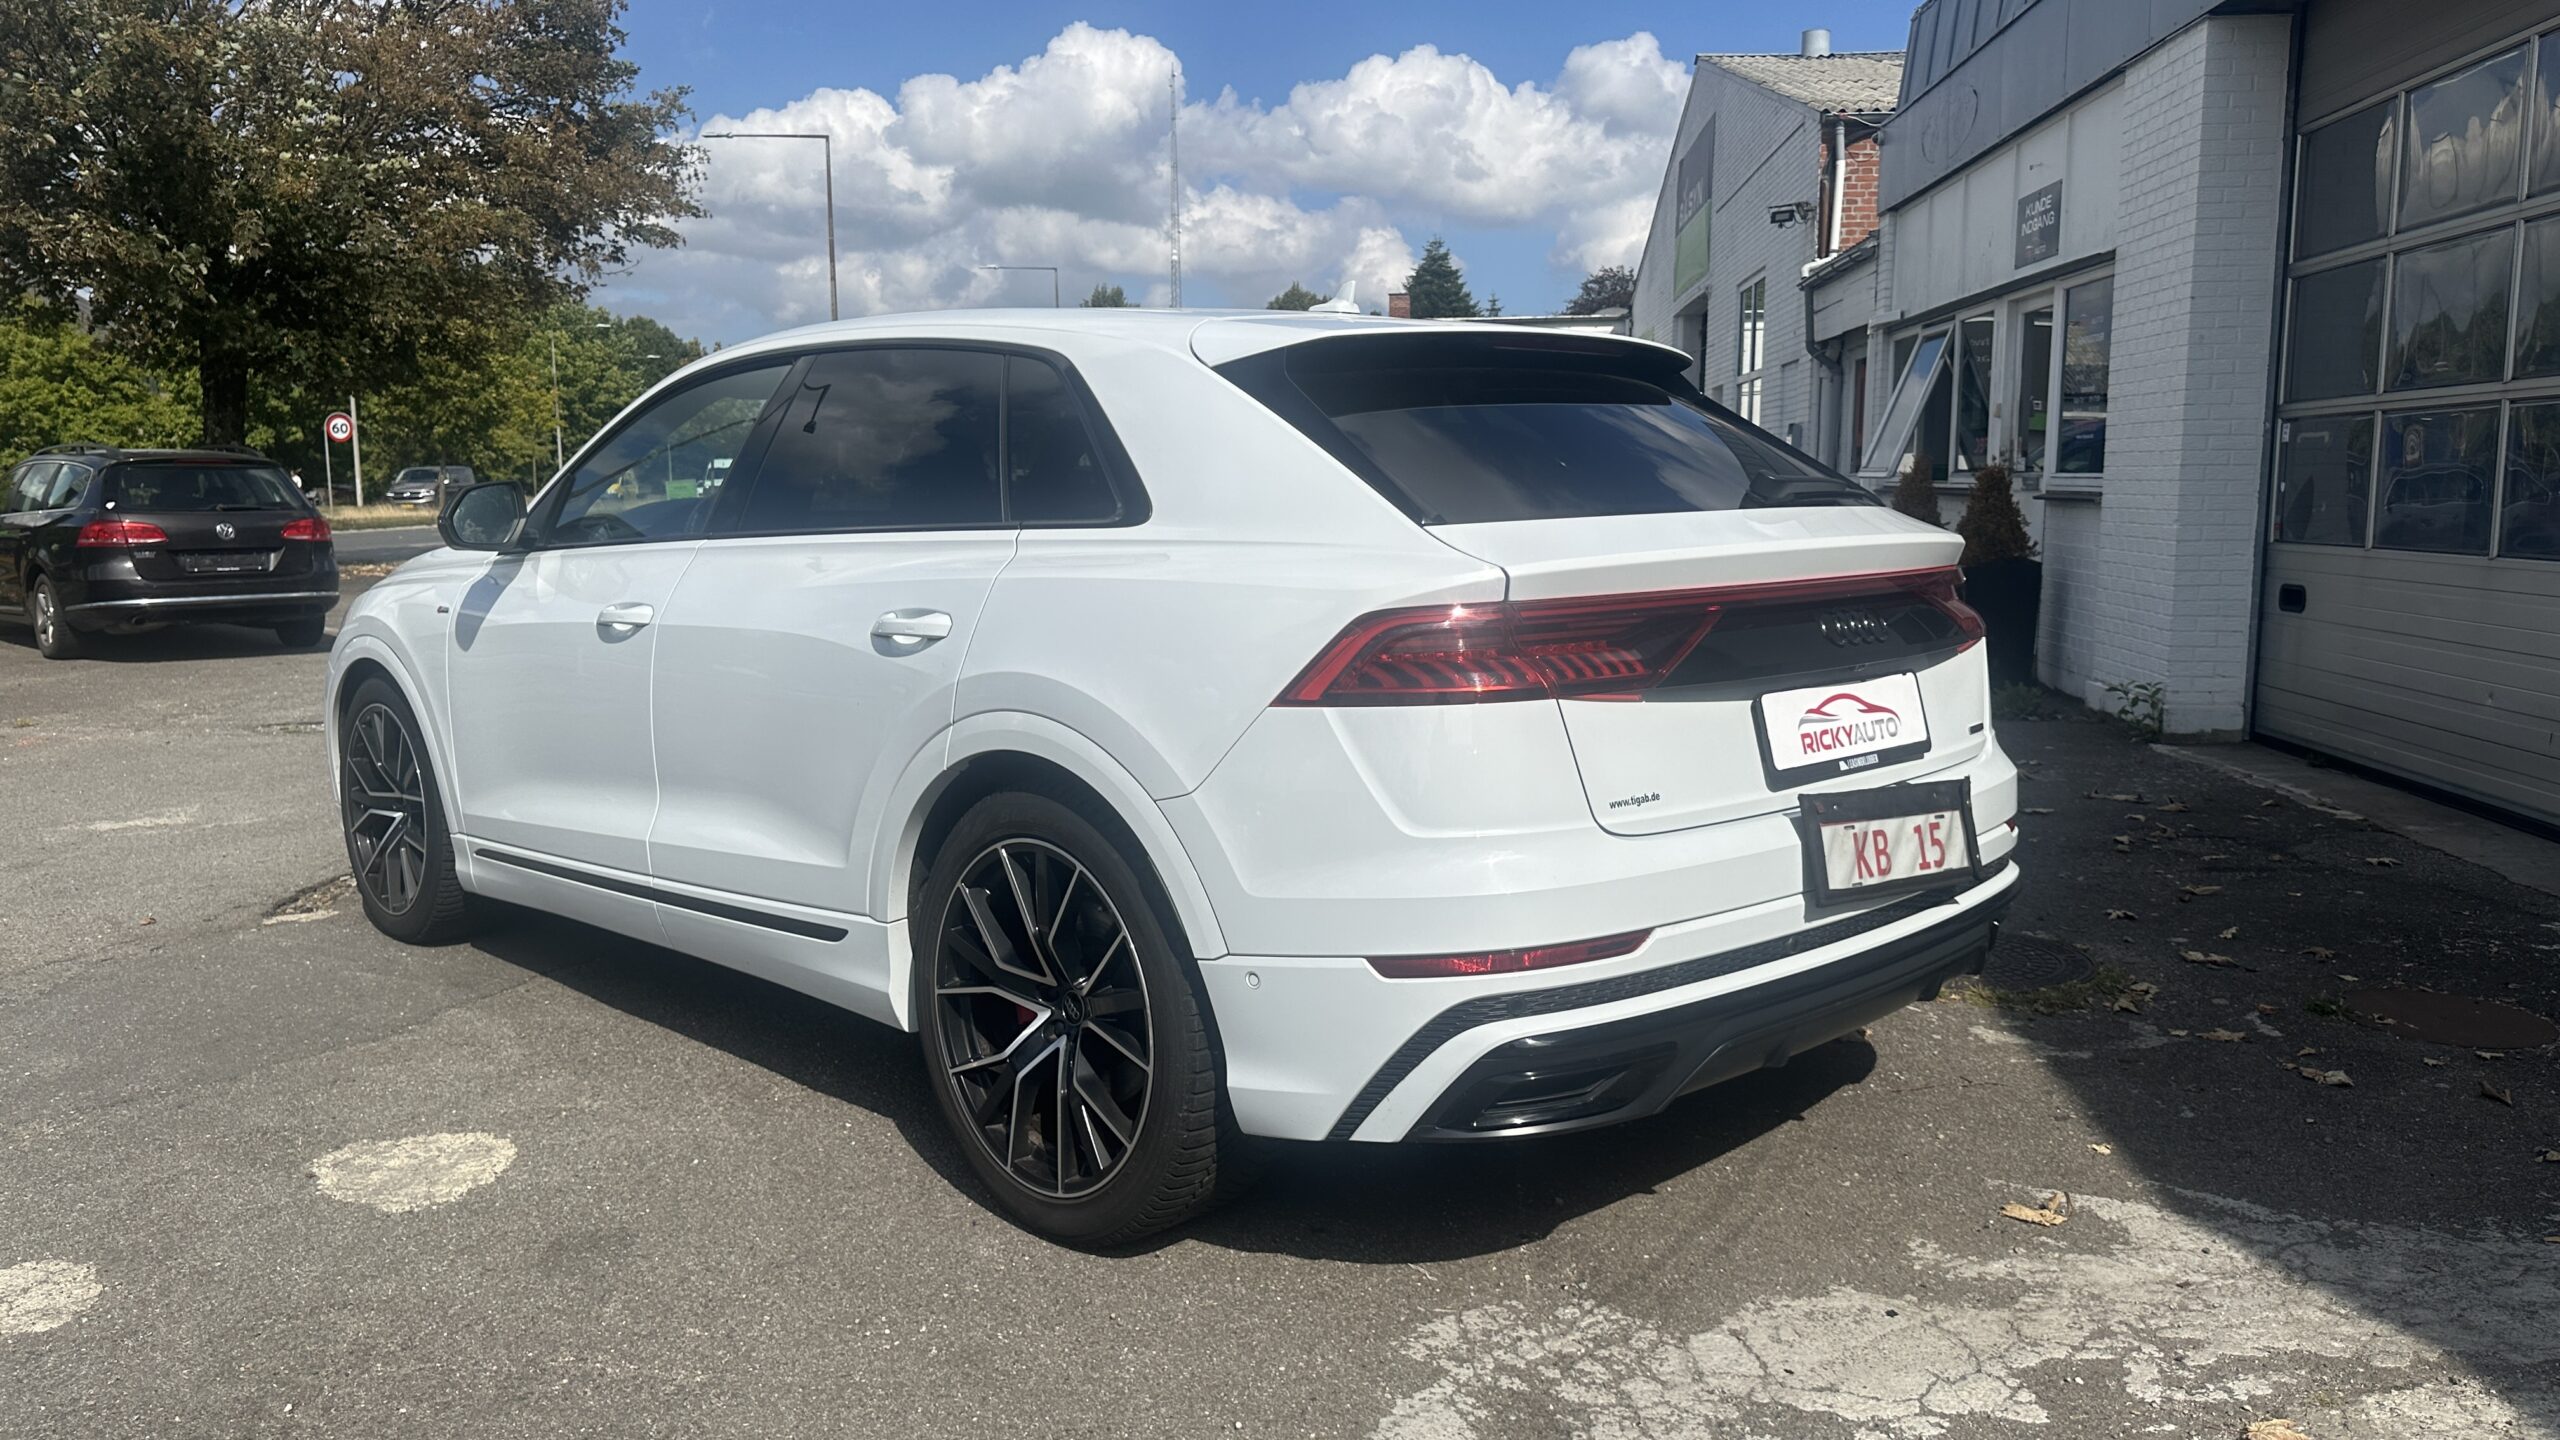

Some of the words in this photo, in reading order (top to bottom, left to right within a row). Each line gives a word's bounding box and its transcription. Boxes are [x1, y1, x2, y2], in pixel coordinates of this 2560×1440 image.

[2025, 194, 2052, 218] KUNDE
[332, 423, 348, 434] 60
[1800, 717, 1898, 755] RICKYAUTO
[1609, 792, 1660, 809] www.tigab.de
[1852, 829, 1892, 879] KB
[1913, 822, 1946, 870] 15
